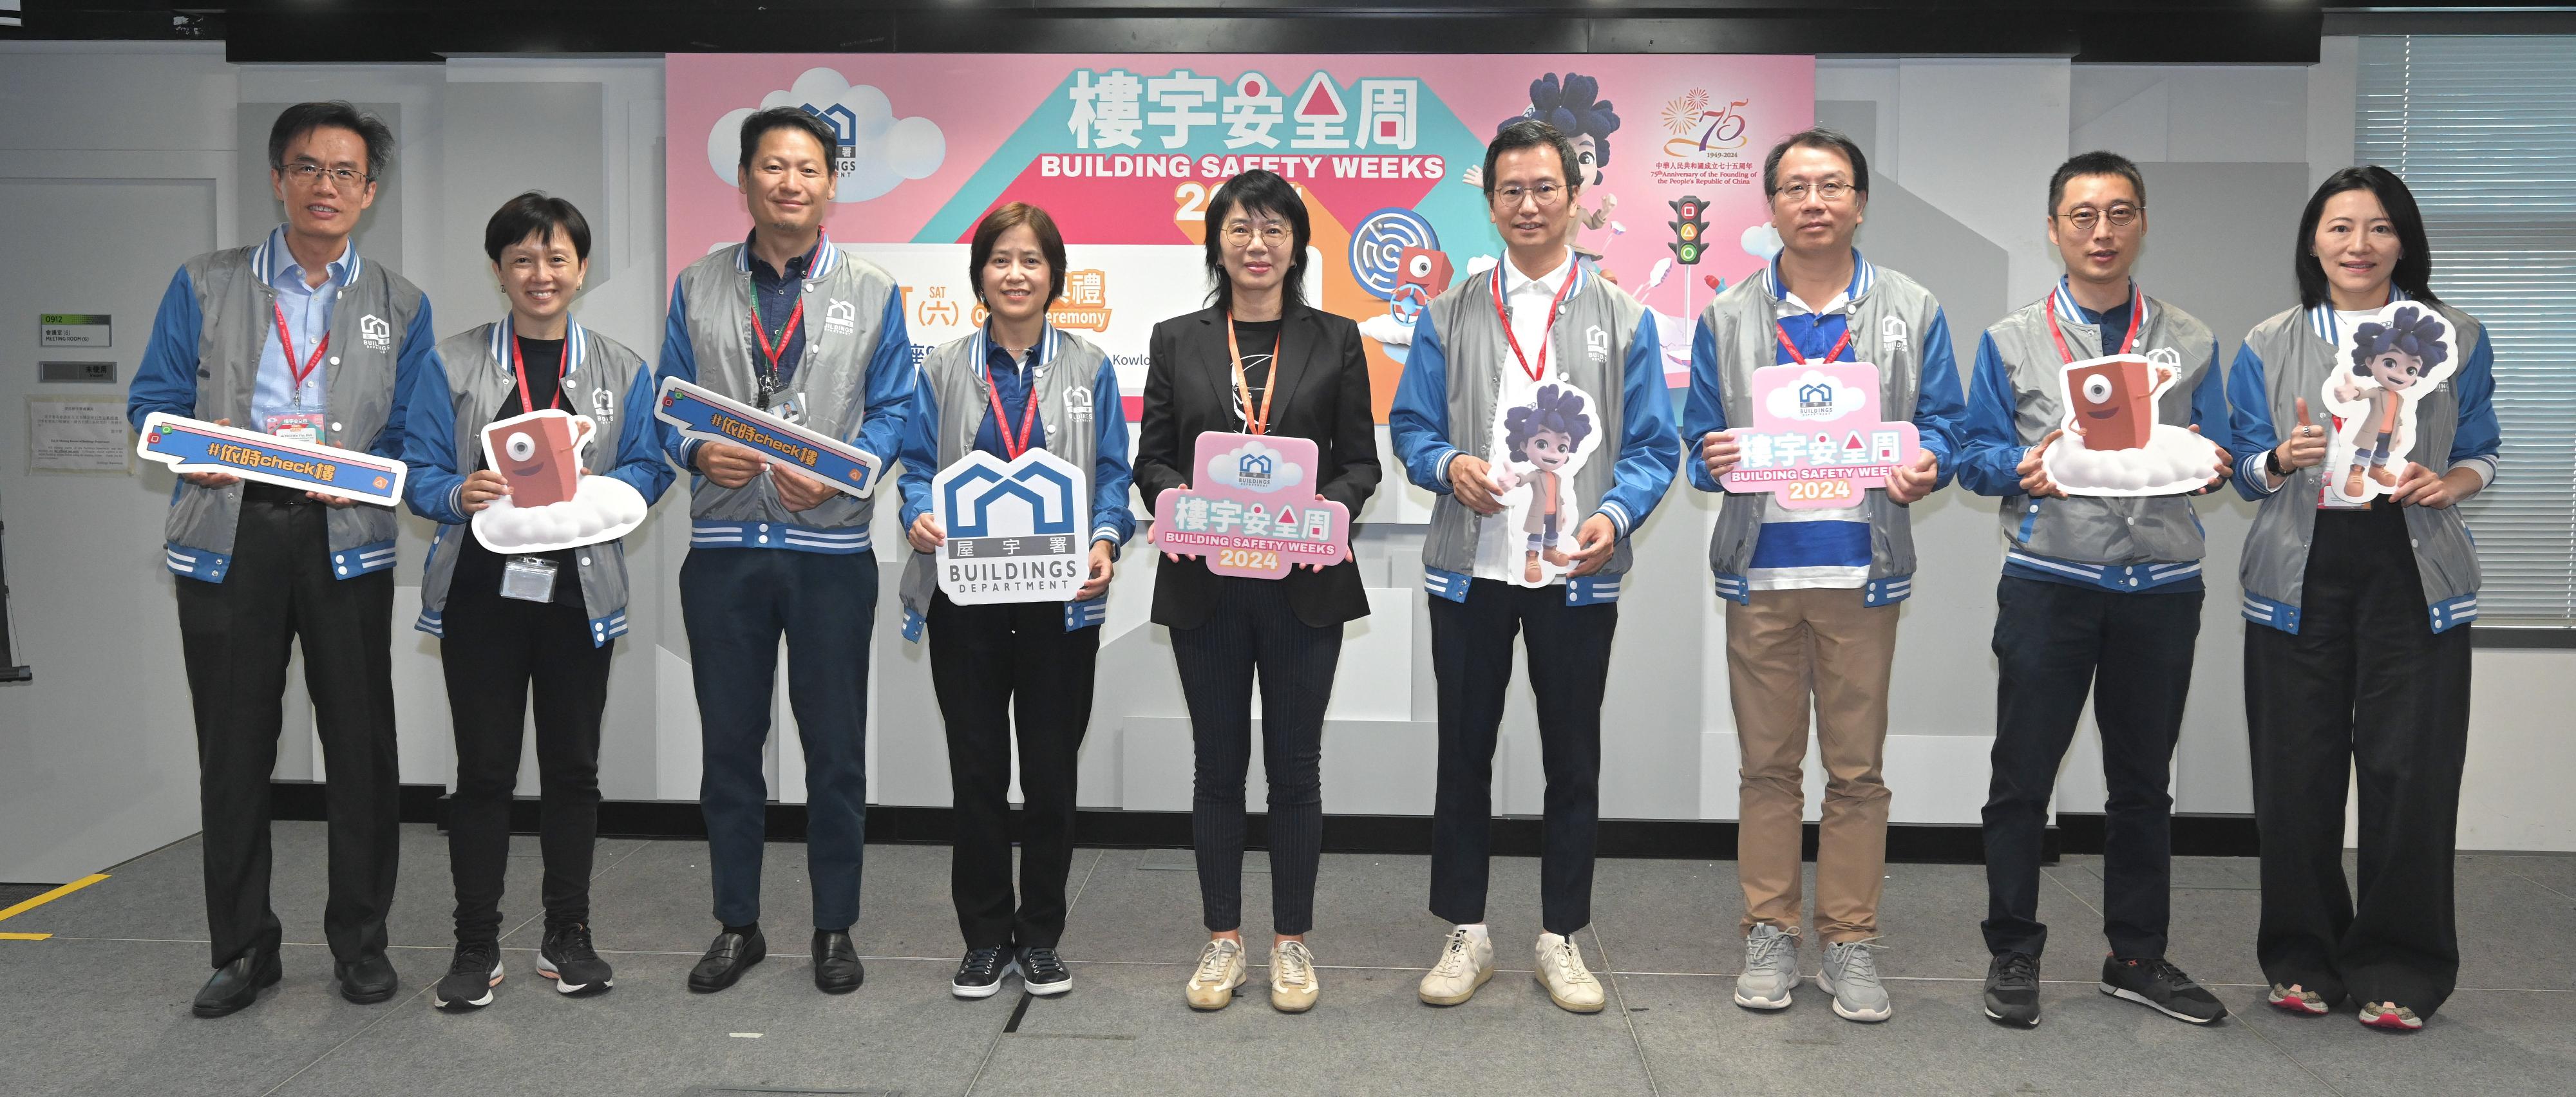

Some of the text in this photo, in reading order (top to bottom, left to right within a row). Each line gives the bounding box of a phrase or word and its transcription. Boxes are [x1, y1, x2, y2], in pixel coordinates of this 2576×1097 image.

[1067, 70, 1417, 149] 樓宇安全周
[1699, 98, 1749, 152] 75
[1041, 156, 1444, 178] BUILDING SAFETY WEEKS
[929, 286, 946, 298] SAT
[918, 301, 958, 326] (六)
[1045, 312, 1106, 327] eremony
[1740, 430, 1900, 468] 樓宇安全周
[1731, 470, 1797, 482] BUILDING
[1801, 468, 1855, 479] SAFETY
[1789, 480, 1850, 499] 2024
[1175, 496, 1331, 541] 樓宇安全周
[957, 536, 1067, 557] 屋宇署
[1166, 532, 1335, 555] BUILDING SAFETY WEEKS
[949, 560, 1076, 582] BUILDINGS
[1220, 550, 1278, 570] 2024
[959, 580, 1068, 593] DEPARTMENT
